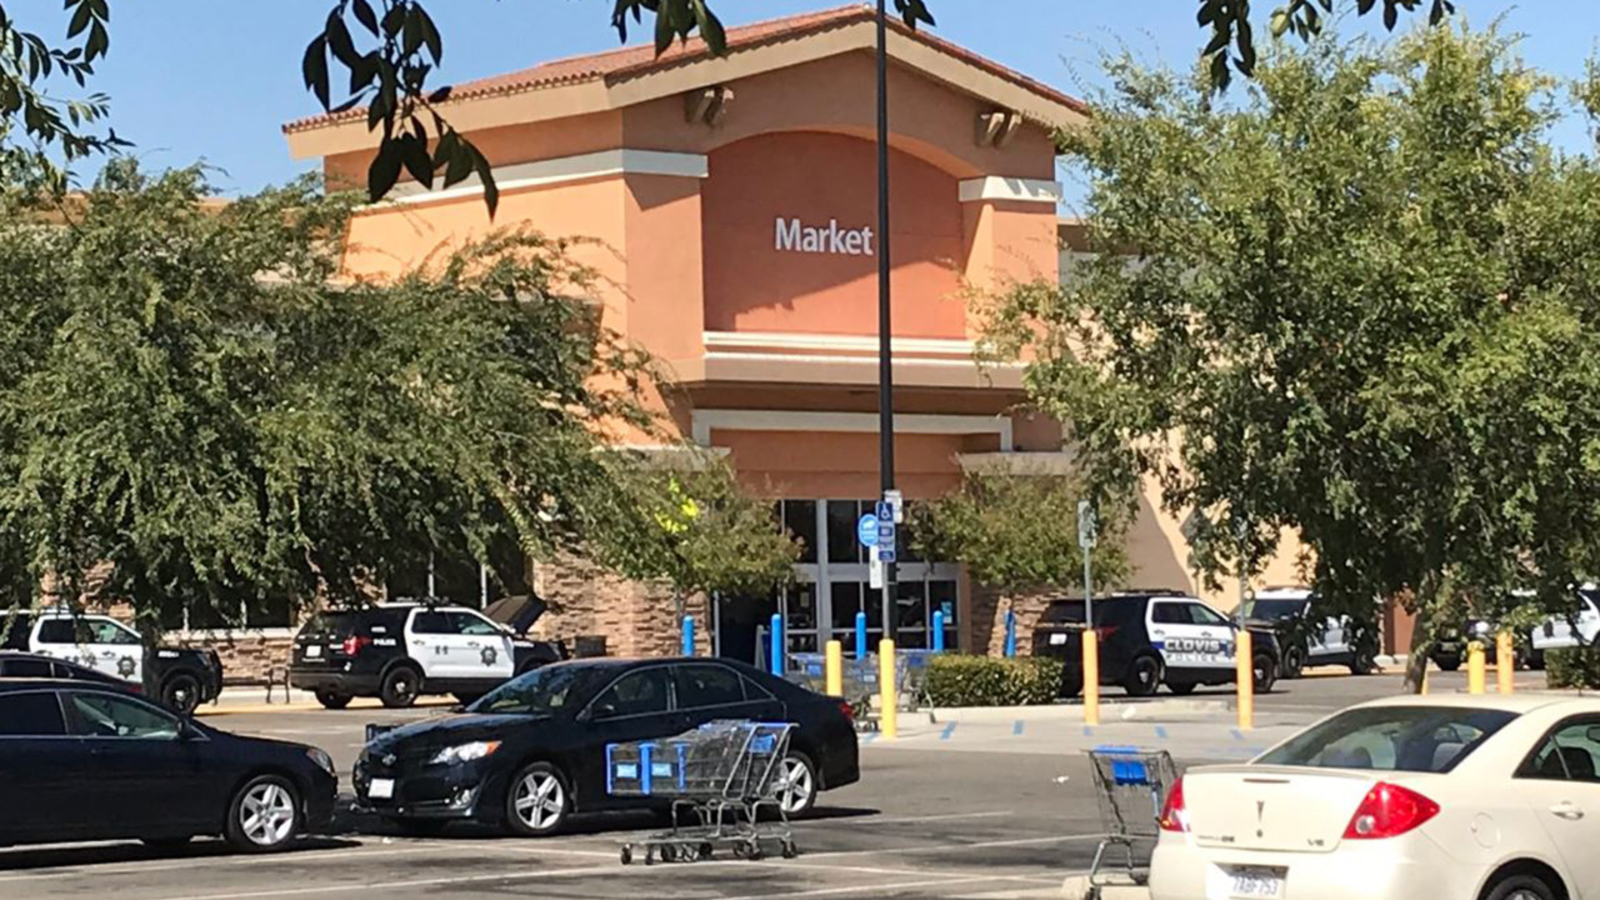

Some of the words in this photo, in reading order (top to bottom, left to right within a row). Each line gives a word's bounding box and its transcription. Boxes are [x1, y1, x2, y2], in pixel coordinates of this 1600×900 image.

[775, 217, 874, 256] Market
[1164, 637, 1220, 653] CLOVIS
[1166, 653, 1217, 662] POLICE
